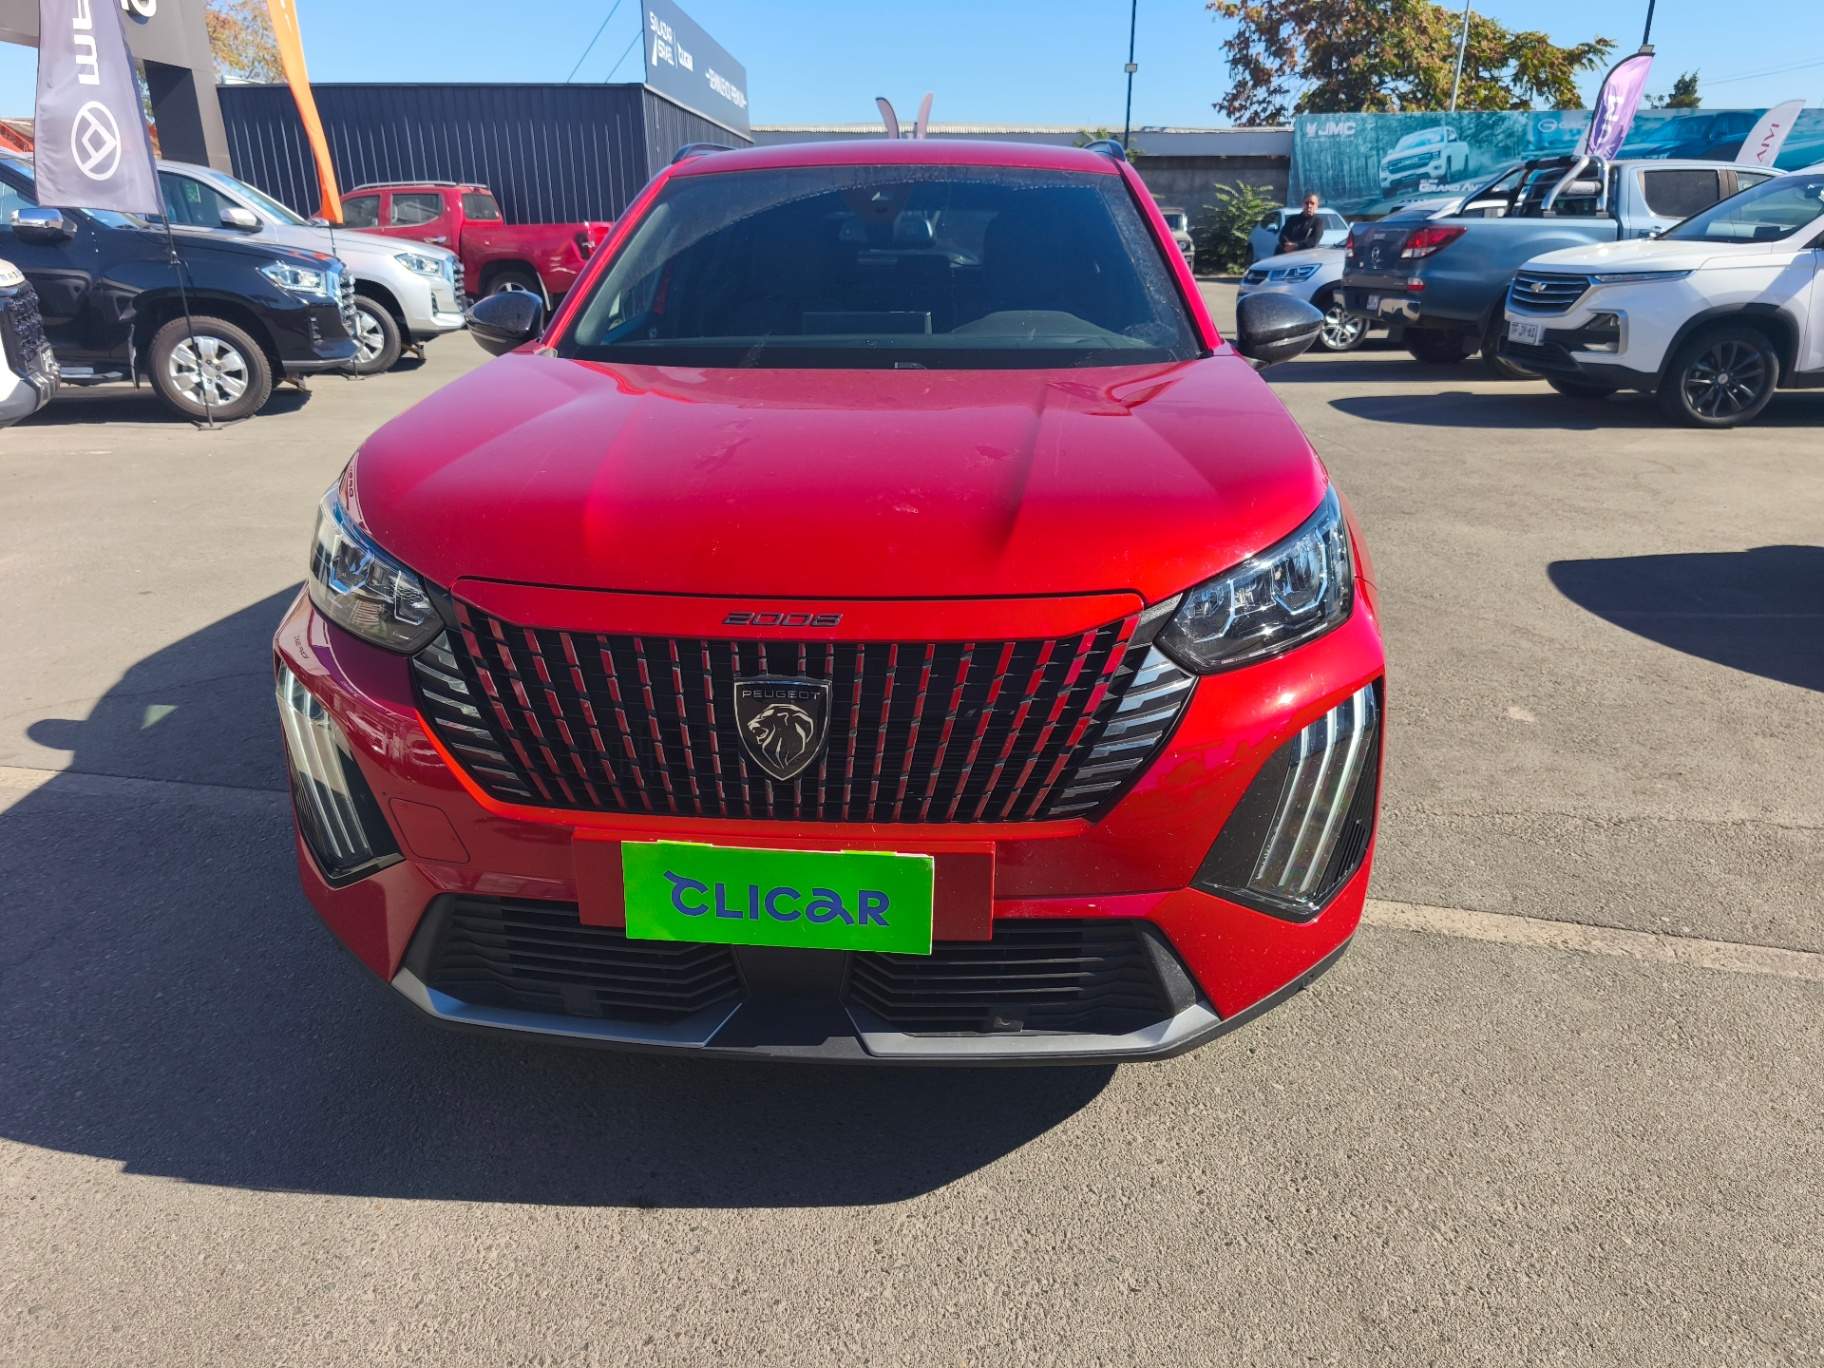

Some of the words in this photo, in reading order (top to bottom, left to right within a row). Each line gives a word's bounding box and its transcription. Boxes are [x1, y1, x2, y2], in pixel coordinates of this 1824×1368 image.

[1318, 121, 1356, 136] JMC
[724, 611, 843, 626] 2008
[742, 690, 821, 700] PEUGEOT
